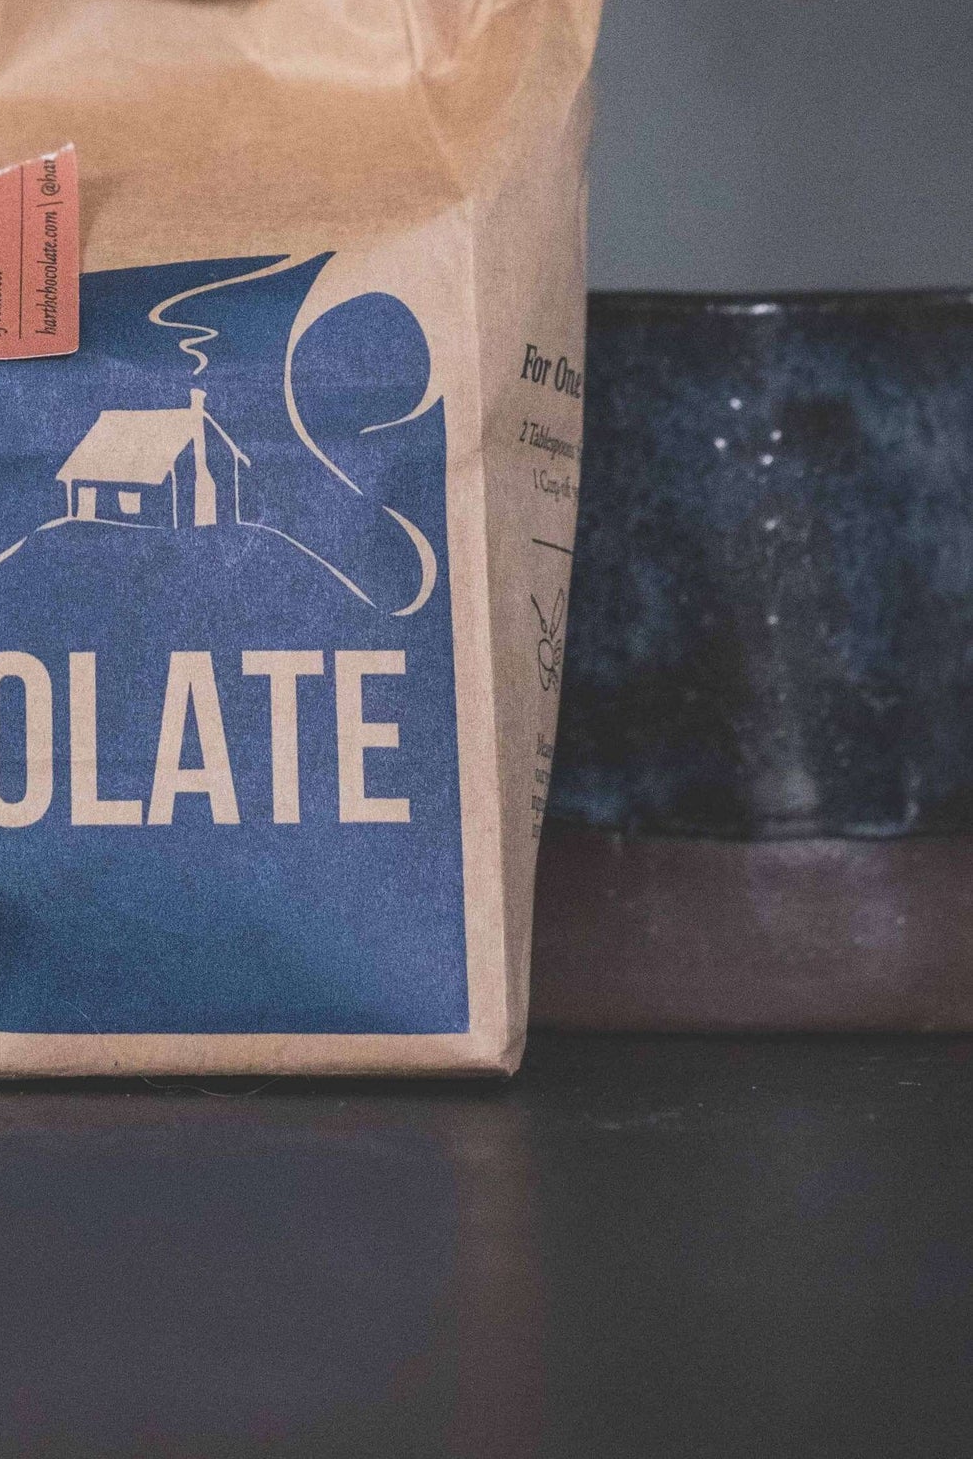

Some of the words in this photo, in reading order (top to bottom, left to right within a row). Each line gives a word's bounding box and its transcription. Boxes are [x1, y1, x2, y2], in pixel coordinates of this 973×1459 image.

[35, 211, 58, 336] harthchocolate.com
[520, 343, 552, 386] For
[554, 355, 582, 399] One
